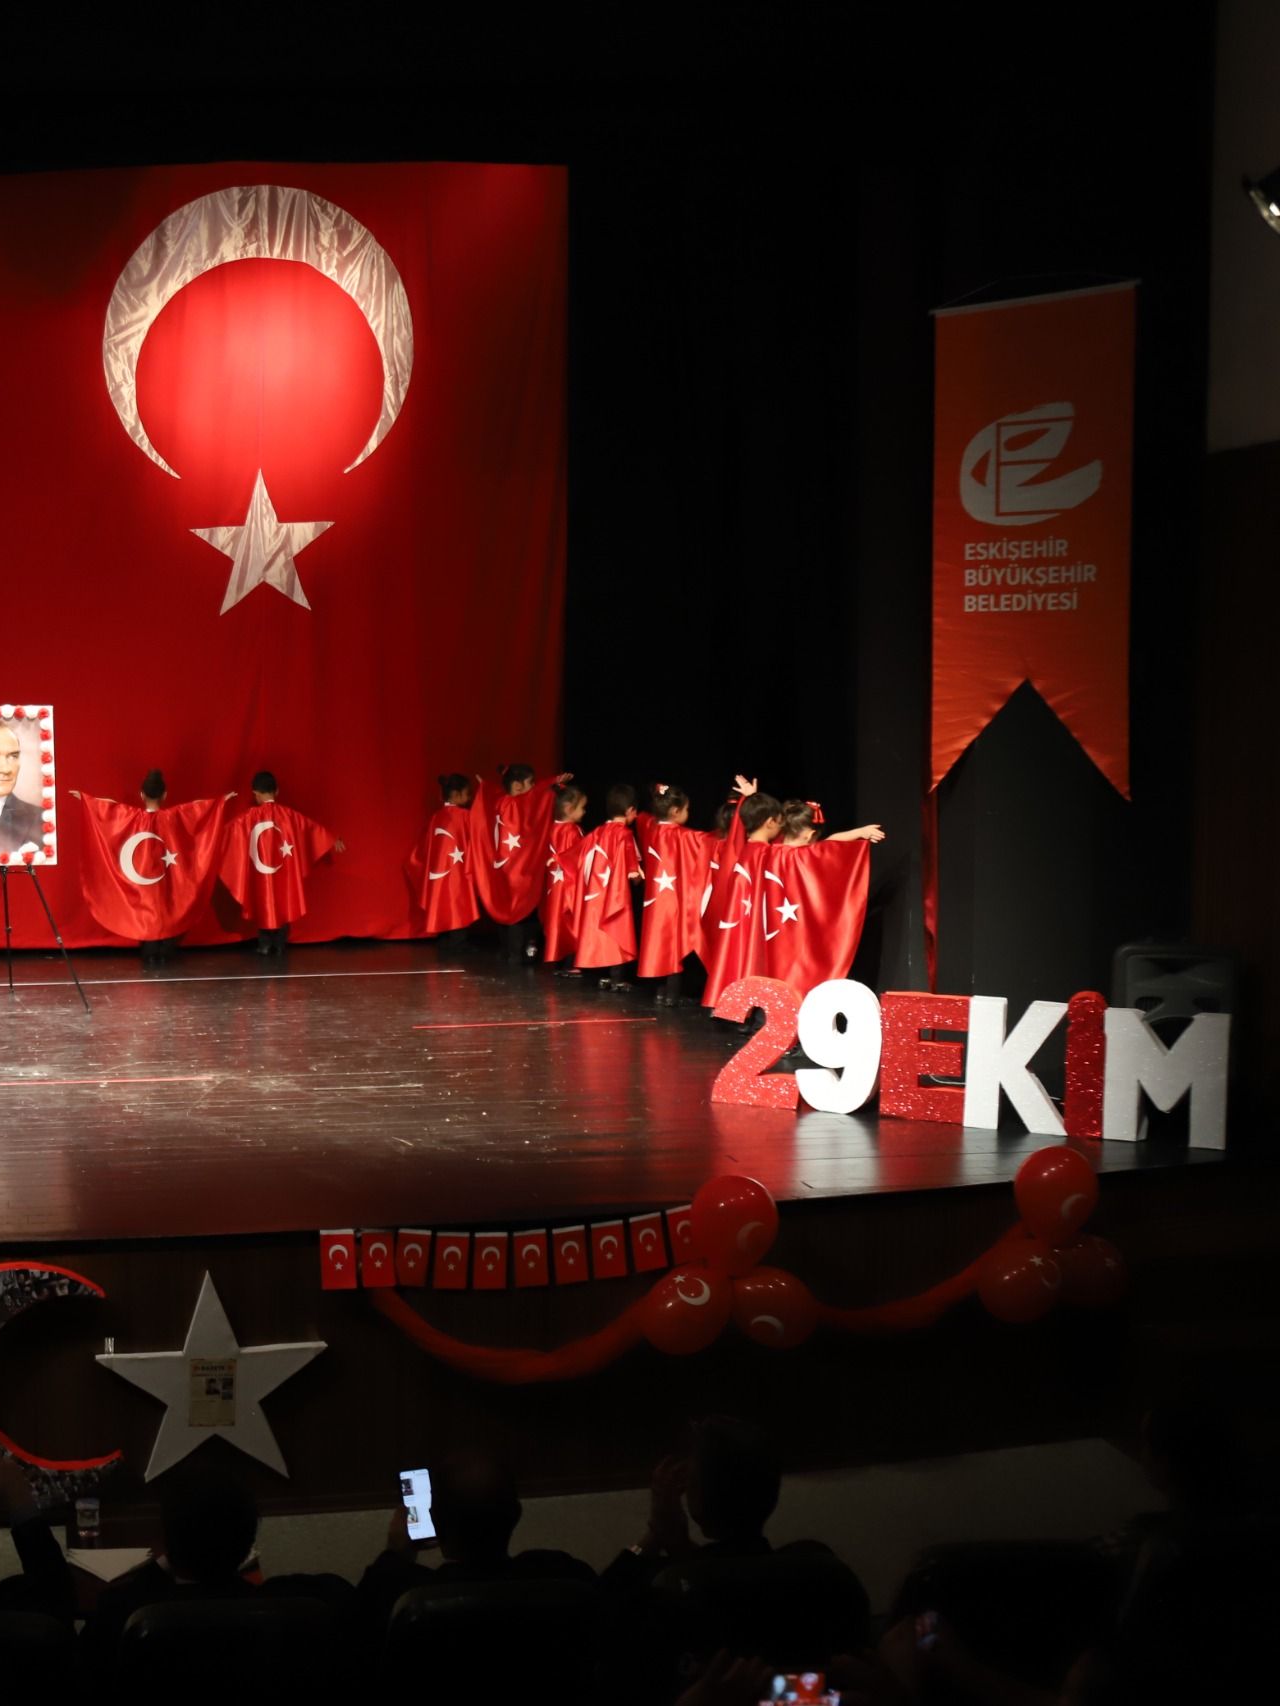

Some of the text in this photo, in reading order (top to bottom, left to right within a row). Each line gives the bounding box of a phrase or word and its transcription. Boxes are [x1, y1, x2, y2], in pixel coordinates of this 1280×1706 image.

[964, 536, 1069, 561] ESKİŞEHİR
[964, 561, 1097, 587] BÜYÜKŞEHİR
[963, 588, 1078, 613] BELEDİYESİ
[711, 976, 883, 1115] 29
